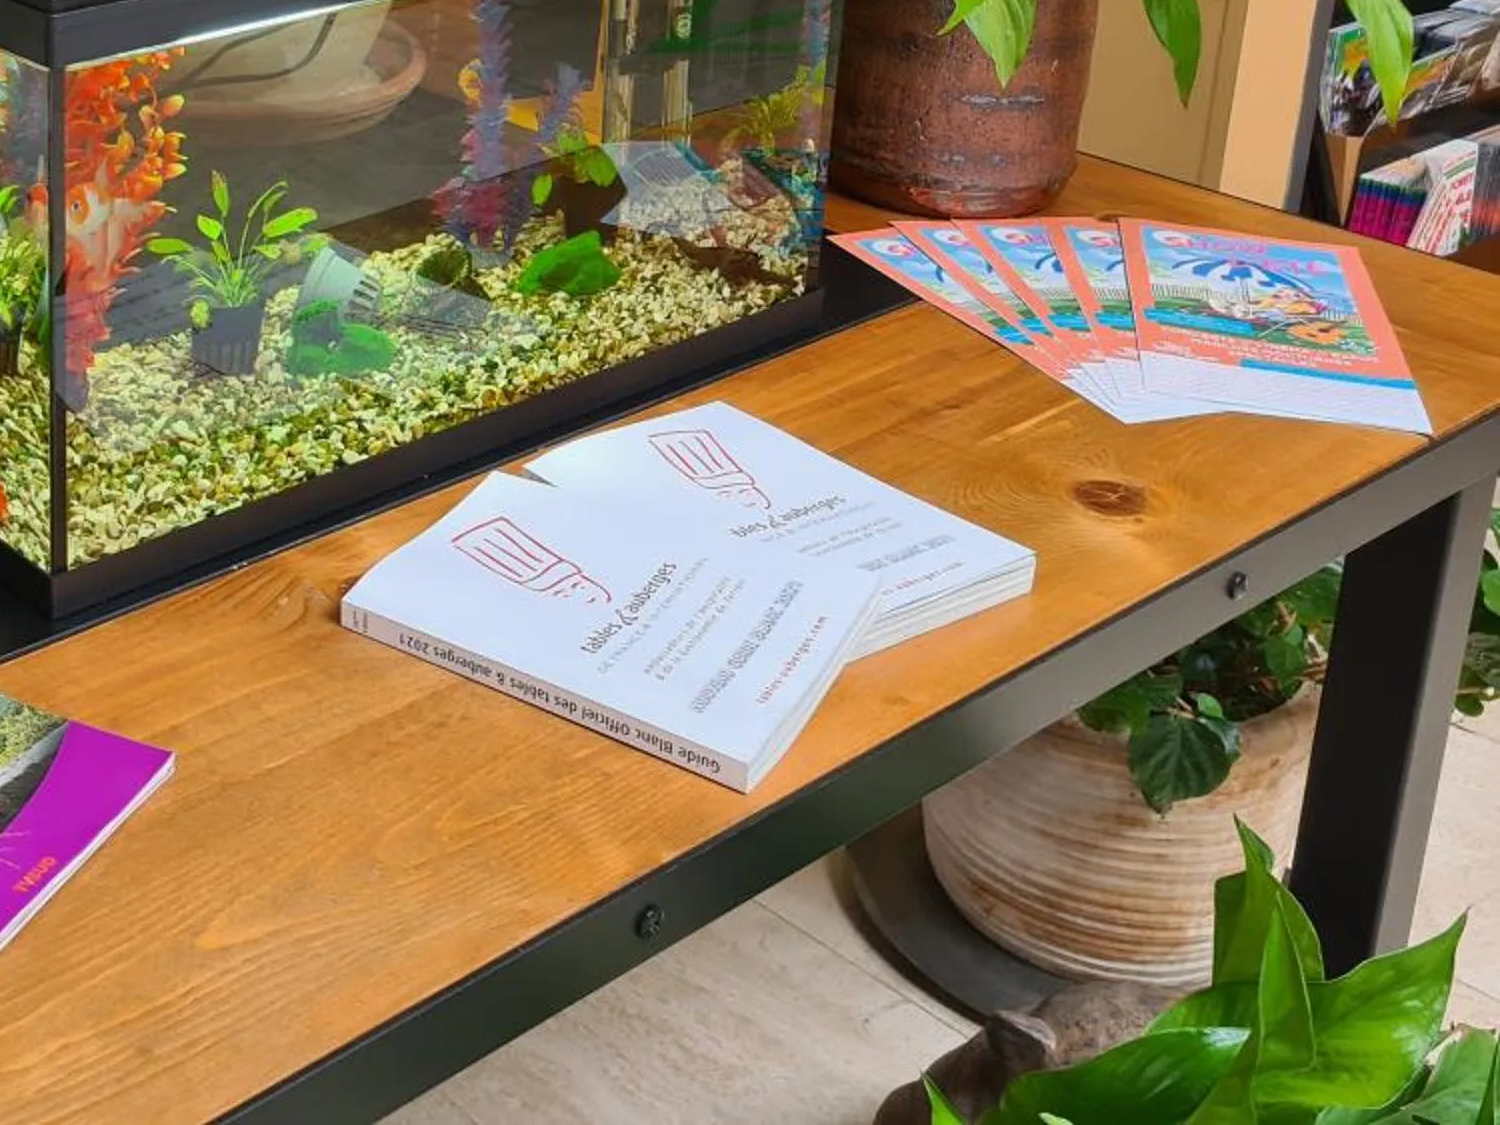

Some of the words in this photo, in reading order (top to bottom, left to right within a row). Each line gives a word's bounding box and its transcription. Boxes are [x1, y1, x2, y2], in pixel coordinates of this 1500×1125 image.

[580, 623, 622, 654] tables
[629, 562, 677, 615] auberges
[398, 633, 429, 658] 2021
[433, 645, 492, 679] auberges
[510, 677, 550, 704] tables
[554, 695, 578, 716] des
[581, 706, 631, 738] Officiel
[636, 727, 674, 756] Blanc
[679, 745, 721, 774] Guide
